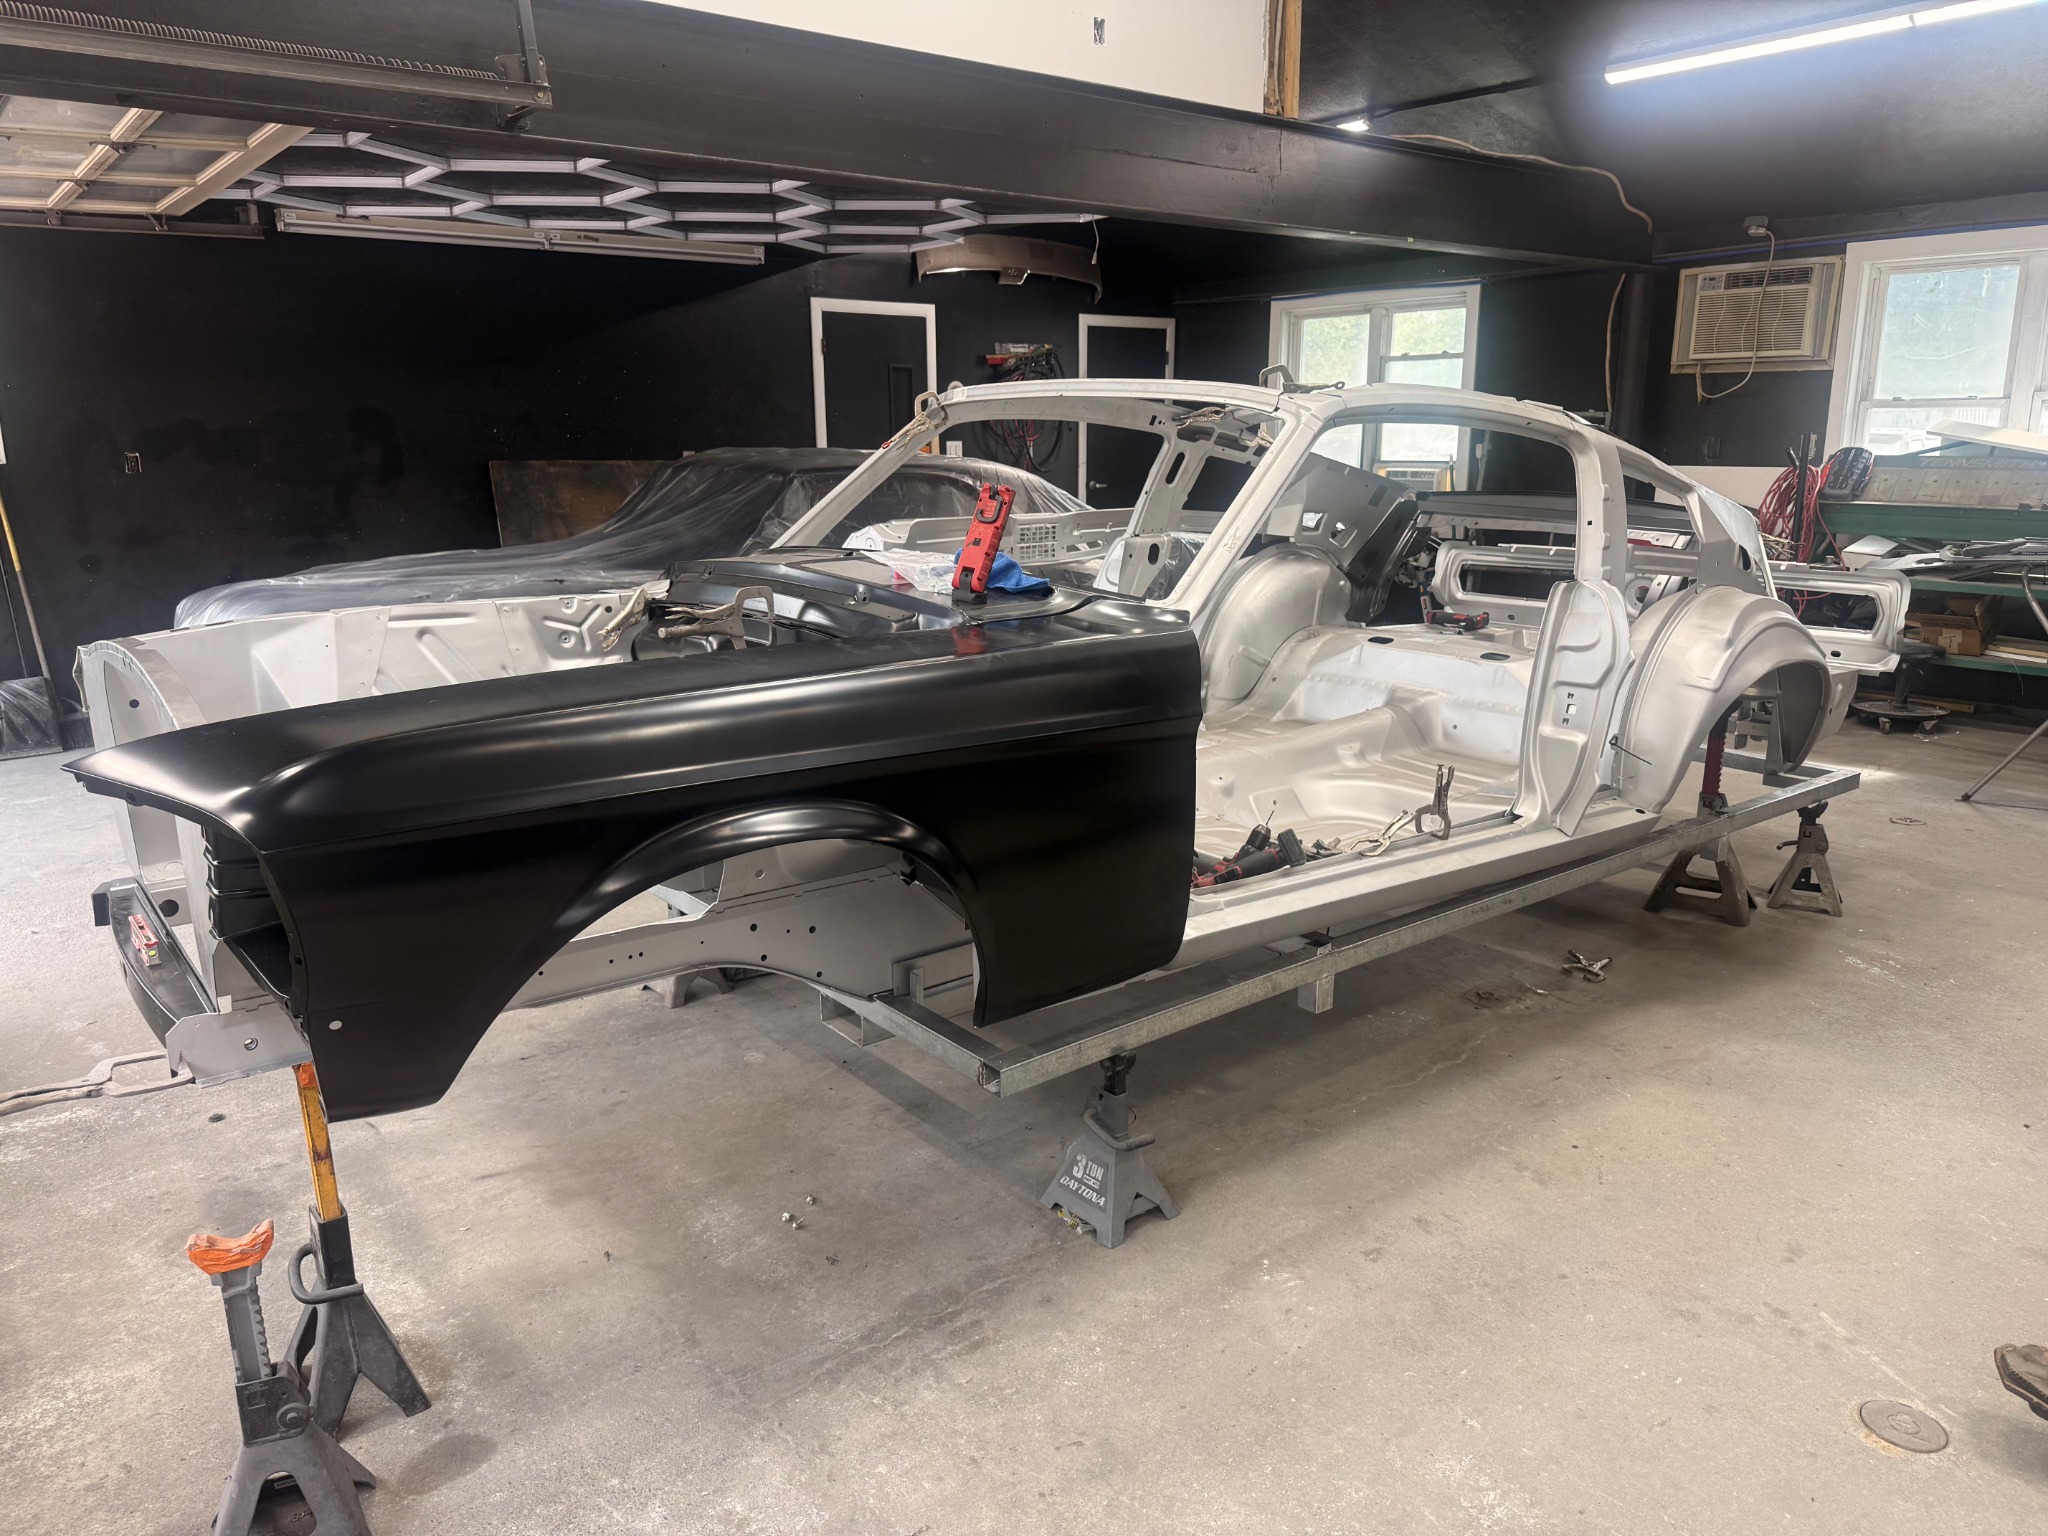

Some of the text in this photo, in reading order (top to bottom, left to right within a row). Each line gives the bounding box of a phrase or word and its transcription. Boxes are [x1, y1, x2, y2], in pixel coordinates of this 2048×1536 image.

[1920, 458, 2037, 469] TENNSMITH
[1072, 1152, 1104, 1181] 3 TON
[1059, 1175, 1106, 1207] DAYTONA
